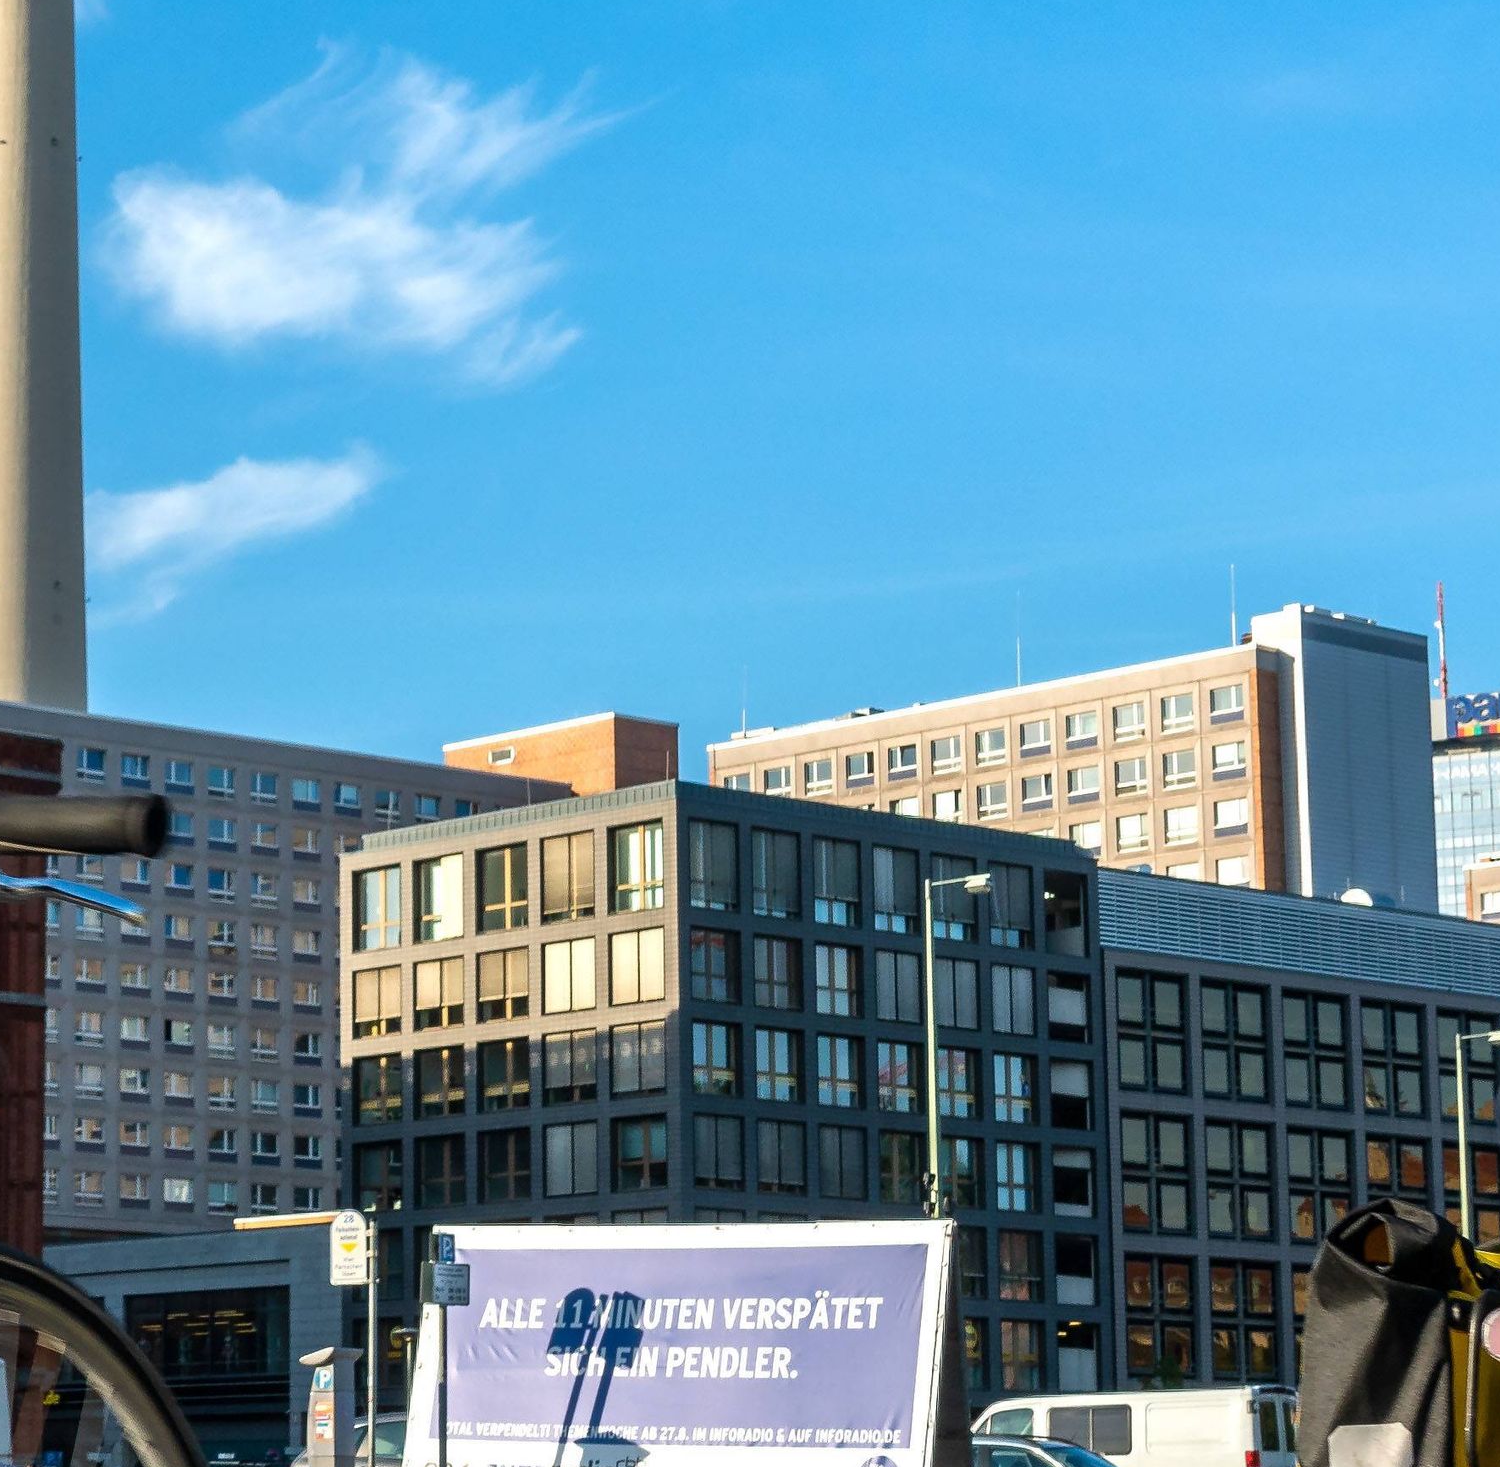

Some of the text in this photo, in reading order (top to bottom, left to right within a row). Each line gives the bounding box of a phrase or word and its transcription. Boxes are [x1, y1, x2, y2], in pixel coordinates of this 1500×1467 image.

[480, 1290, 884, 1330] ALLE 11 MINUTEN VERSPÄTET
[544, 1345, 799, 1380] SICH EIN PENDLER.
[446, 1421, 474, 1437] OTAL
[641, 1426, 658, 1441] AB
[692, 1427, 707, 1442] IM
[709, 1428, 774, 1443] INFORADIO
[776, 1428, 786, 1443] &
[788, 1428, 813, 1444] AUF
[815, 1428, 902, 1444] INFORADIO.DE
